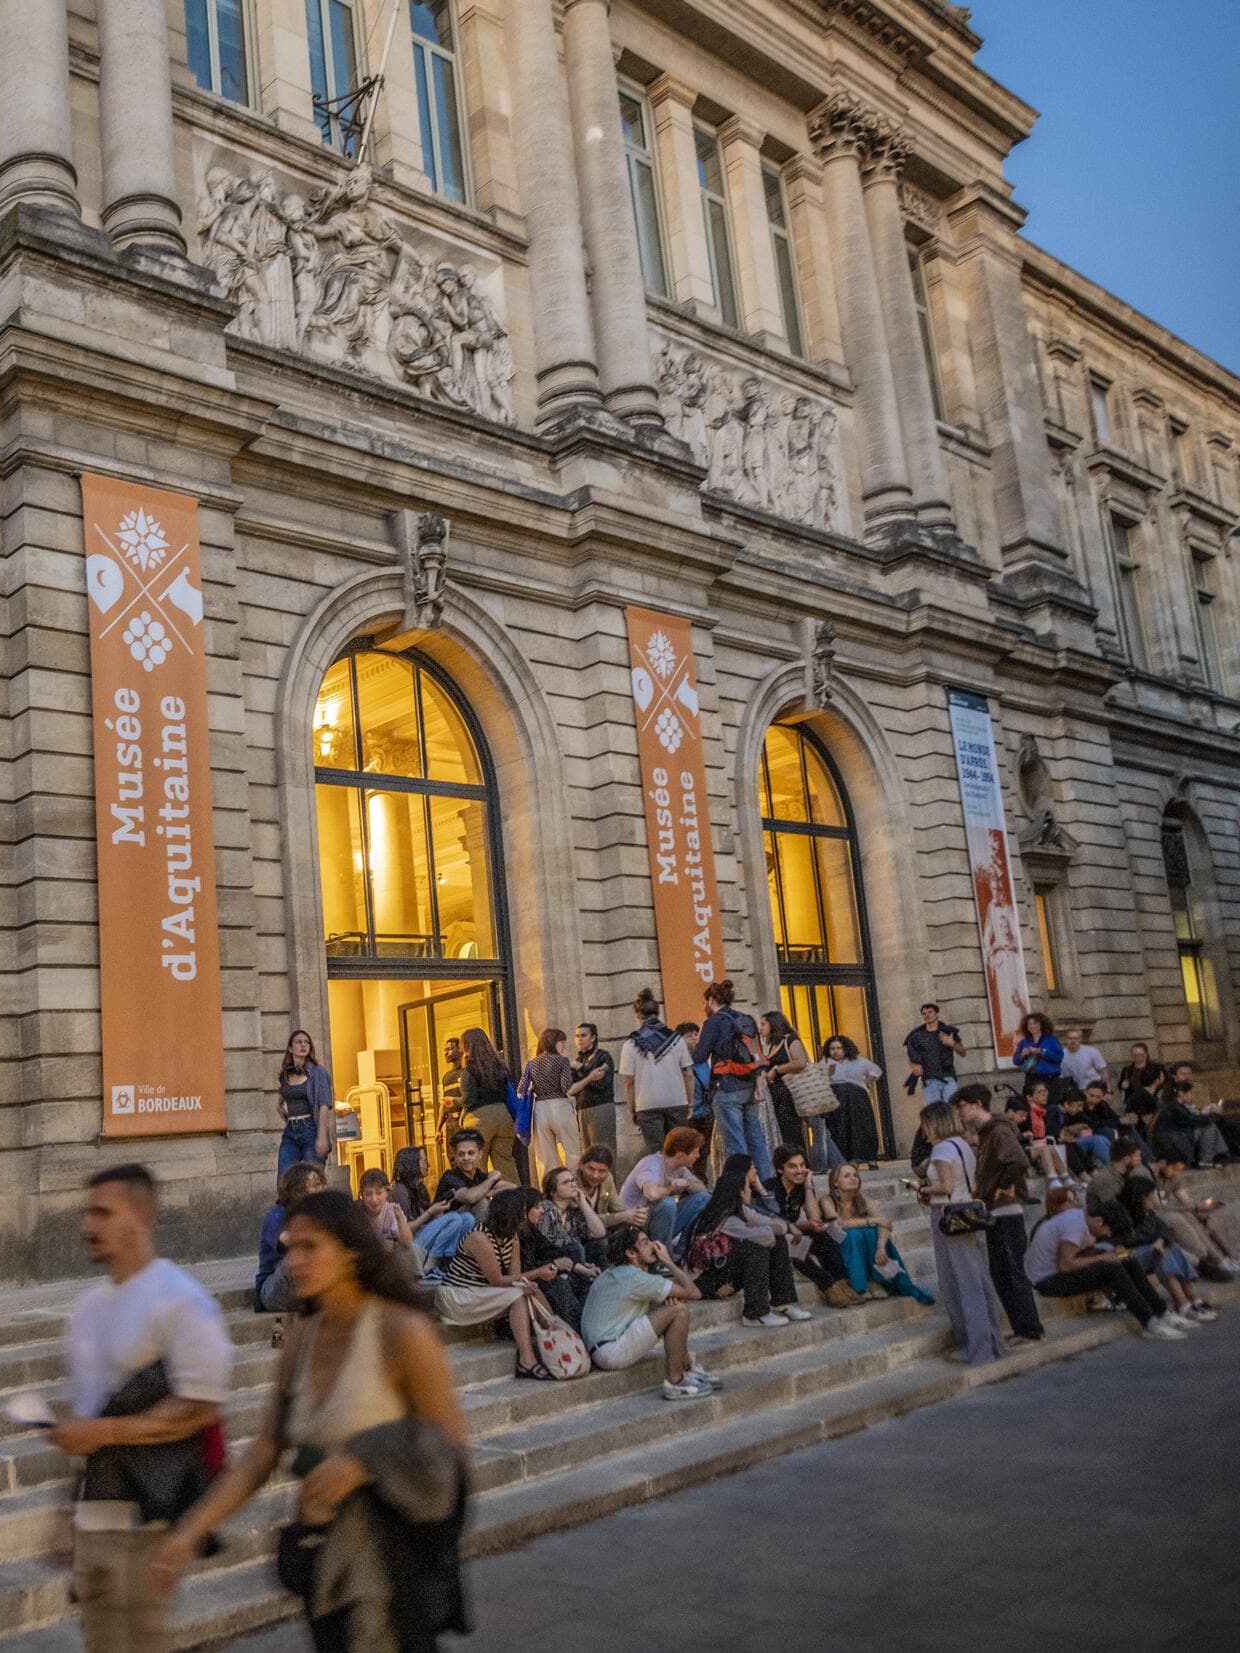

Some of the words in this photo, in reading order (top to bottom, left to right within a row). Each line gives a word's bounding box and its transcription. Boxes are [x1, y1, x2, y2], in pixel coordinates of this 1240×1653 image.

[104, 688, 146, 847] Musée
[649, 767, 679, 886] Musée
[153, 695, 201, 982] d'Aquitaine
[680, 770, 715, 984] d'Aquitaine
[138, 1084, 155, 1094] Ville
[156, 1084, 166, 1094] de
[138, 1096, 203, 1113] BORDEAUX
